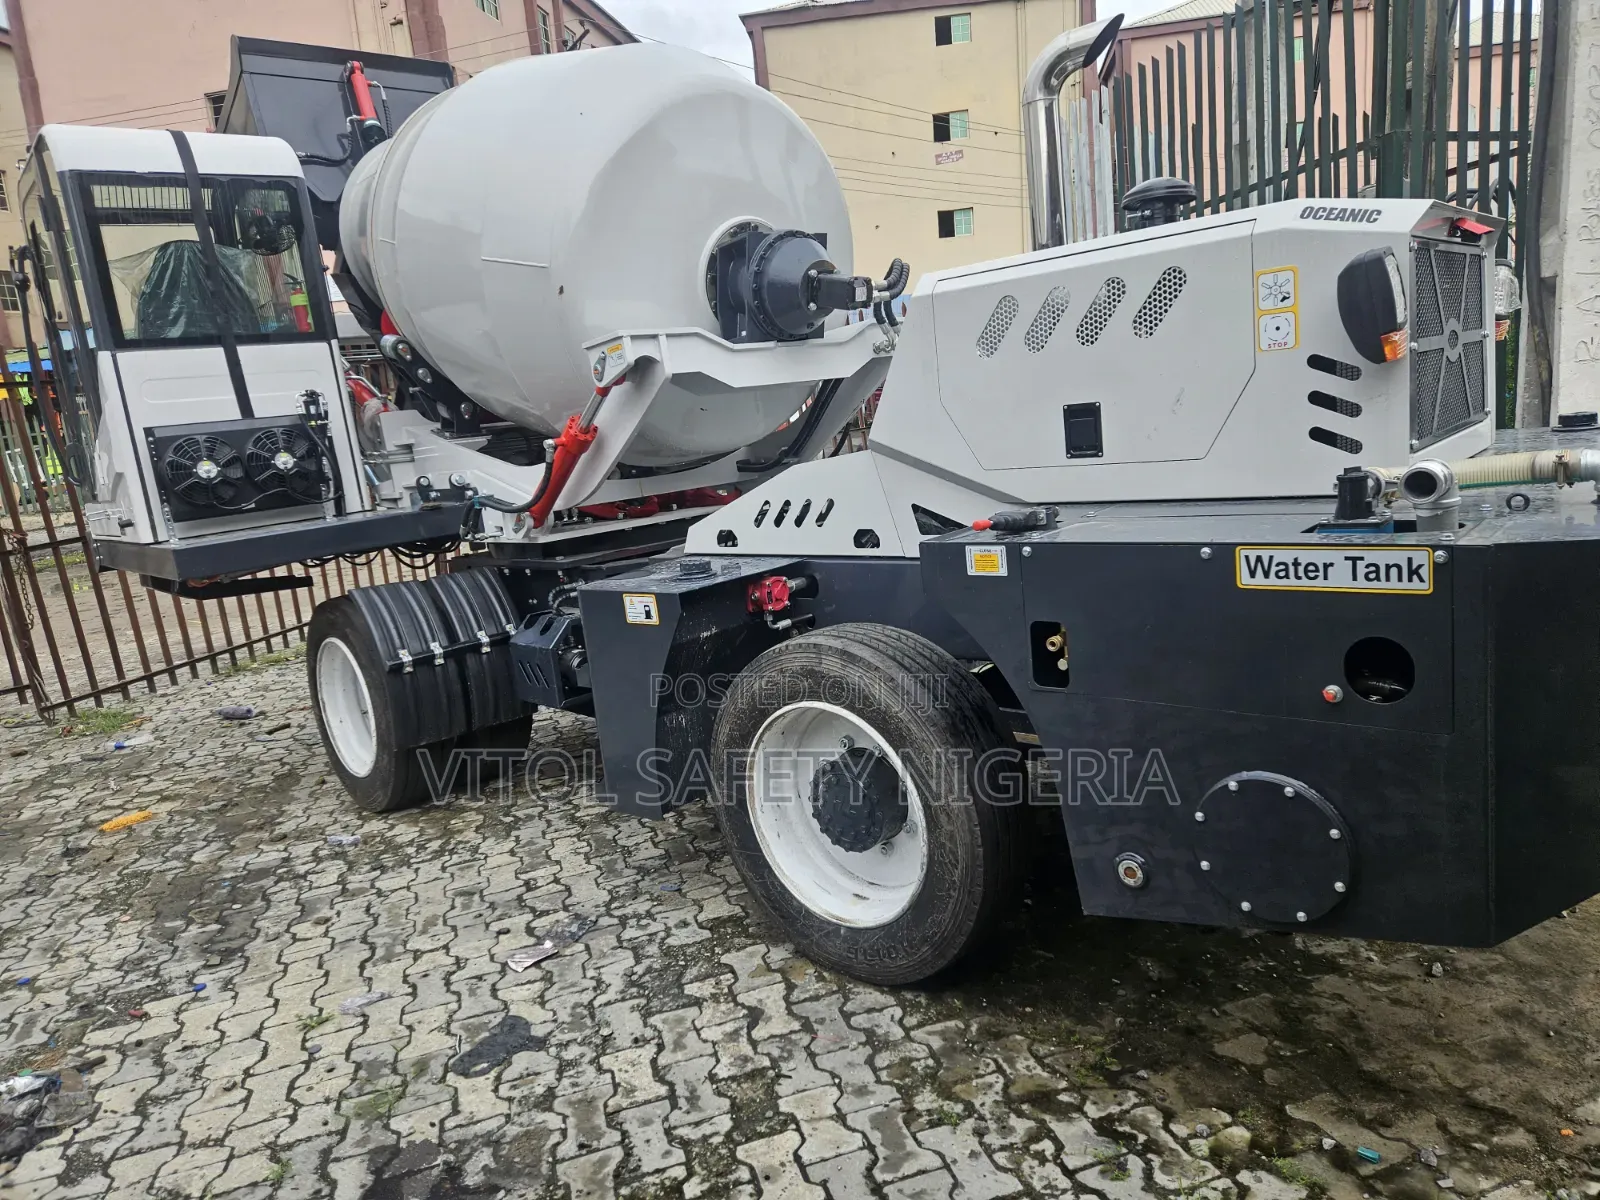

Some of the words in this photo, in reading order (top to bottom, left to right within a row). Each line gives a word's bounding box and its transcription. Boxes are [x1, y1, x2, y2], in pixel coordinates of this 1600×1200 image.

[1300, 206, 1382, 223] OCEANIC
[1244, 554, 1335, 581] Water
[1344, 556, 1426, 583] Tank
